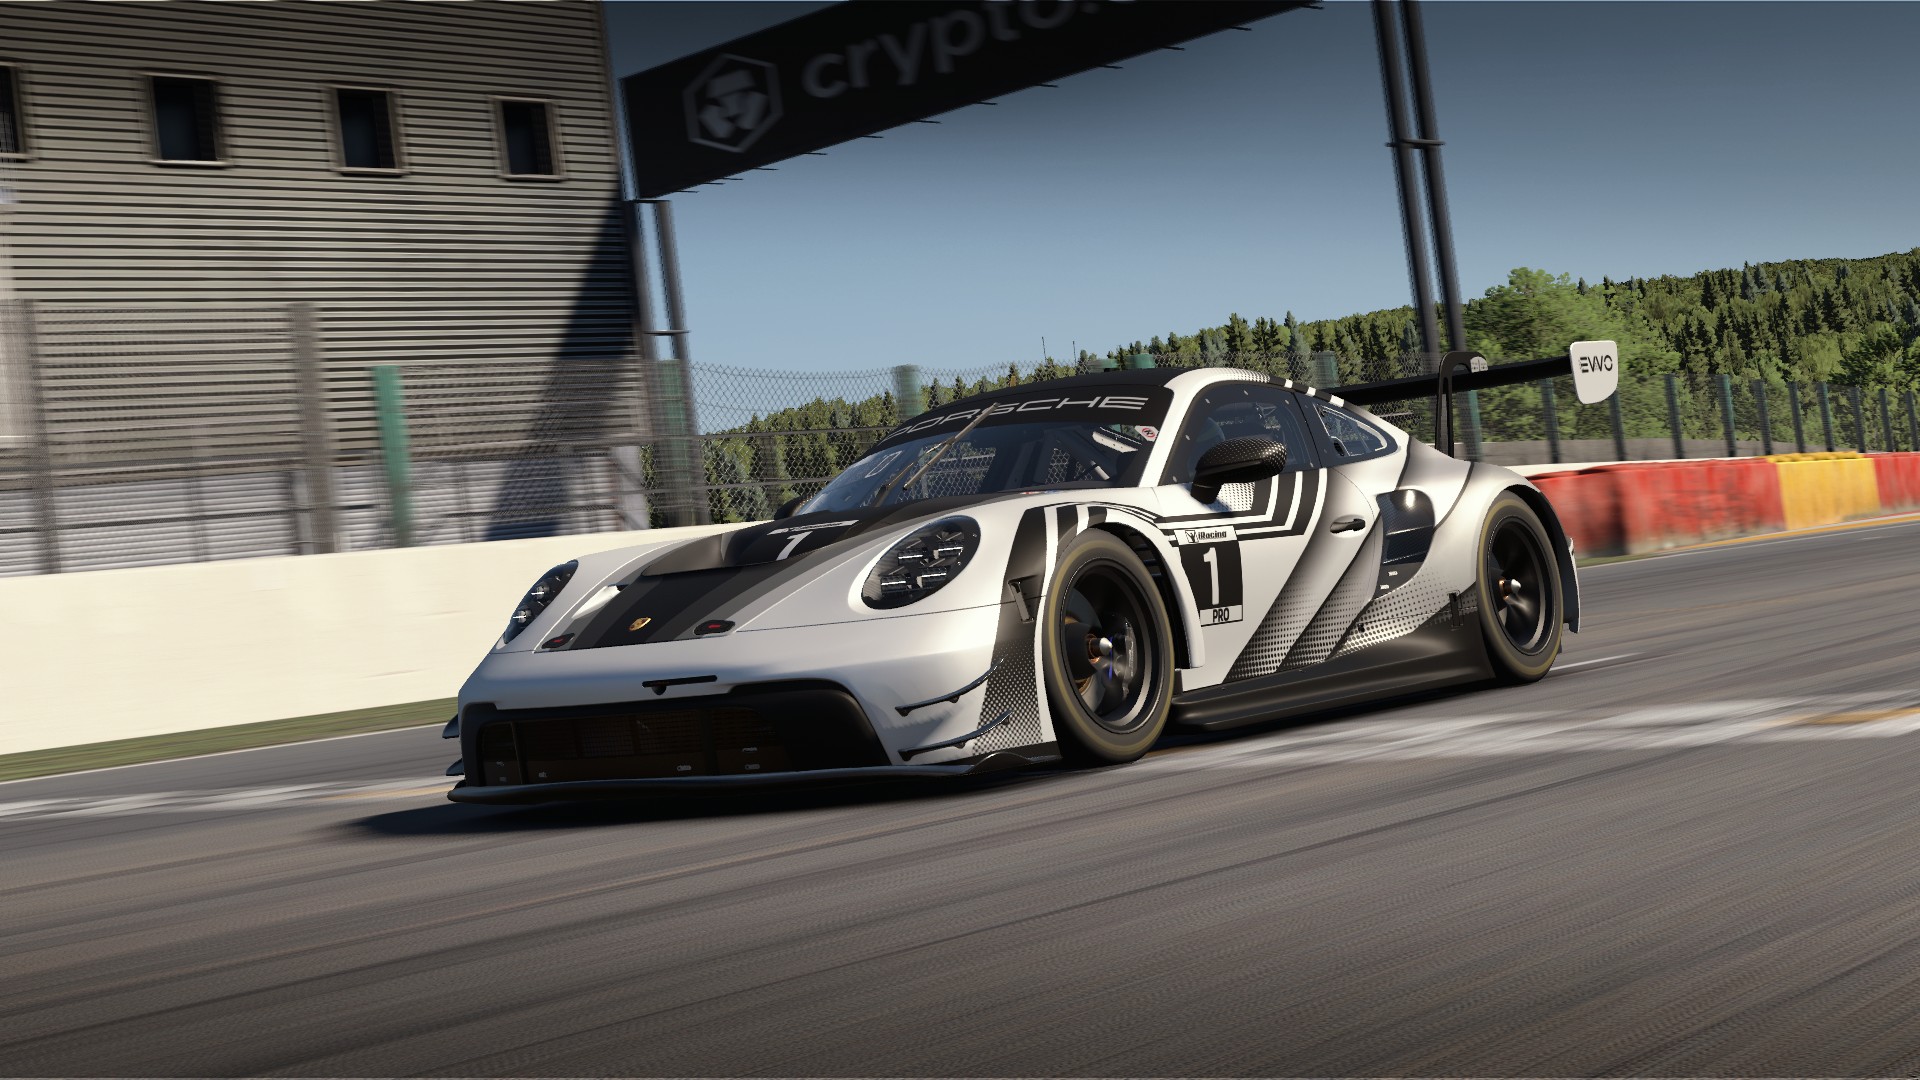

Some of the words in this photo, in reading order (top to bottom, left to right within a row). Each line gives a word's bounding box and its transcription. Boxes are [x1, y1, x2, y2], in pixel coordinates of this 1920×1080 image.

[801, 0, 1136, 99] crypto.
[877, 396, 1149, 446] PORSCHE
[776, 530, 813, 561] 1
[1197, 530, 1227, 540] iRacing
[1203, 547, 1220, 606] 1
[1212, 607, 1230, 623] PRO
